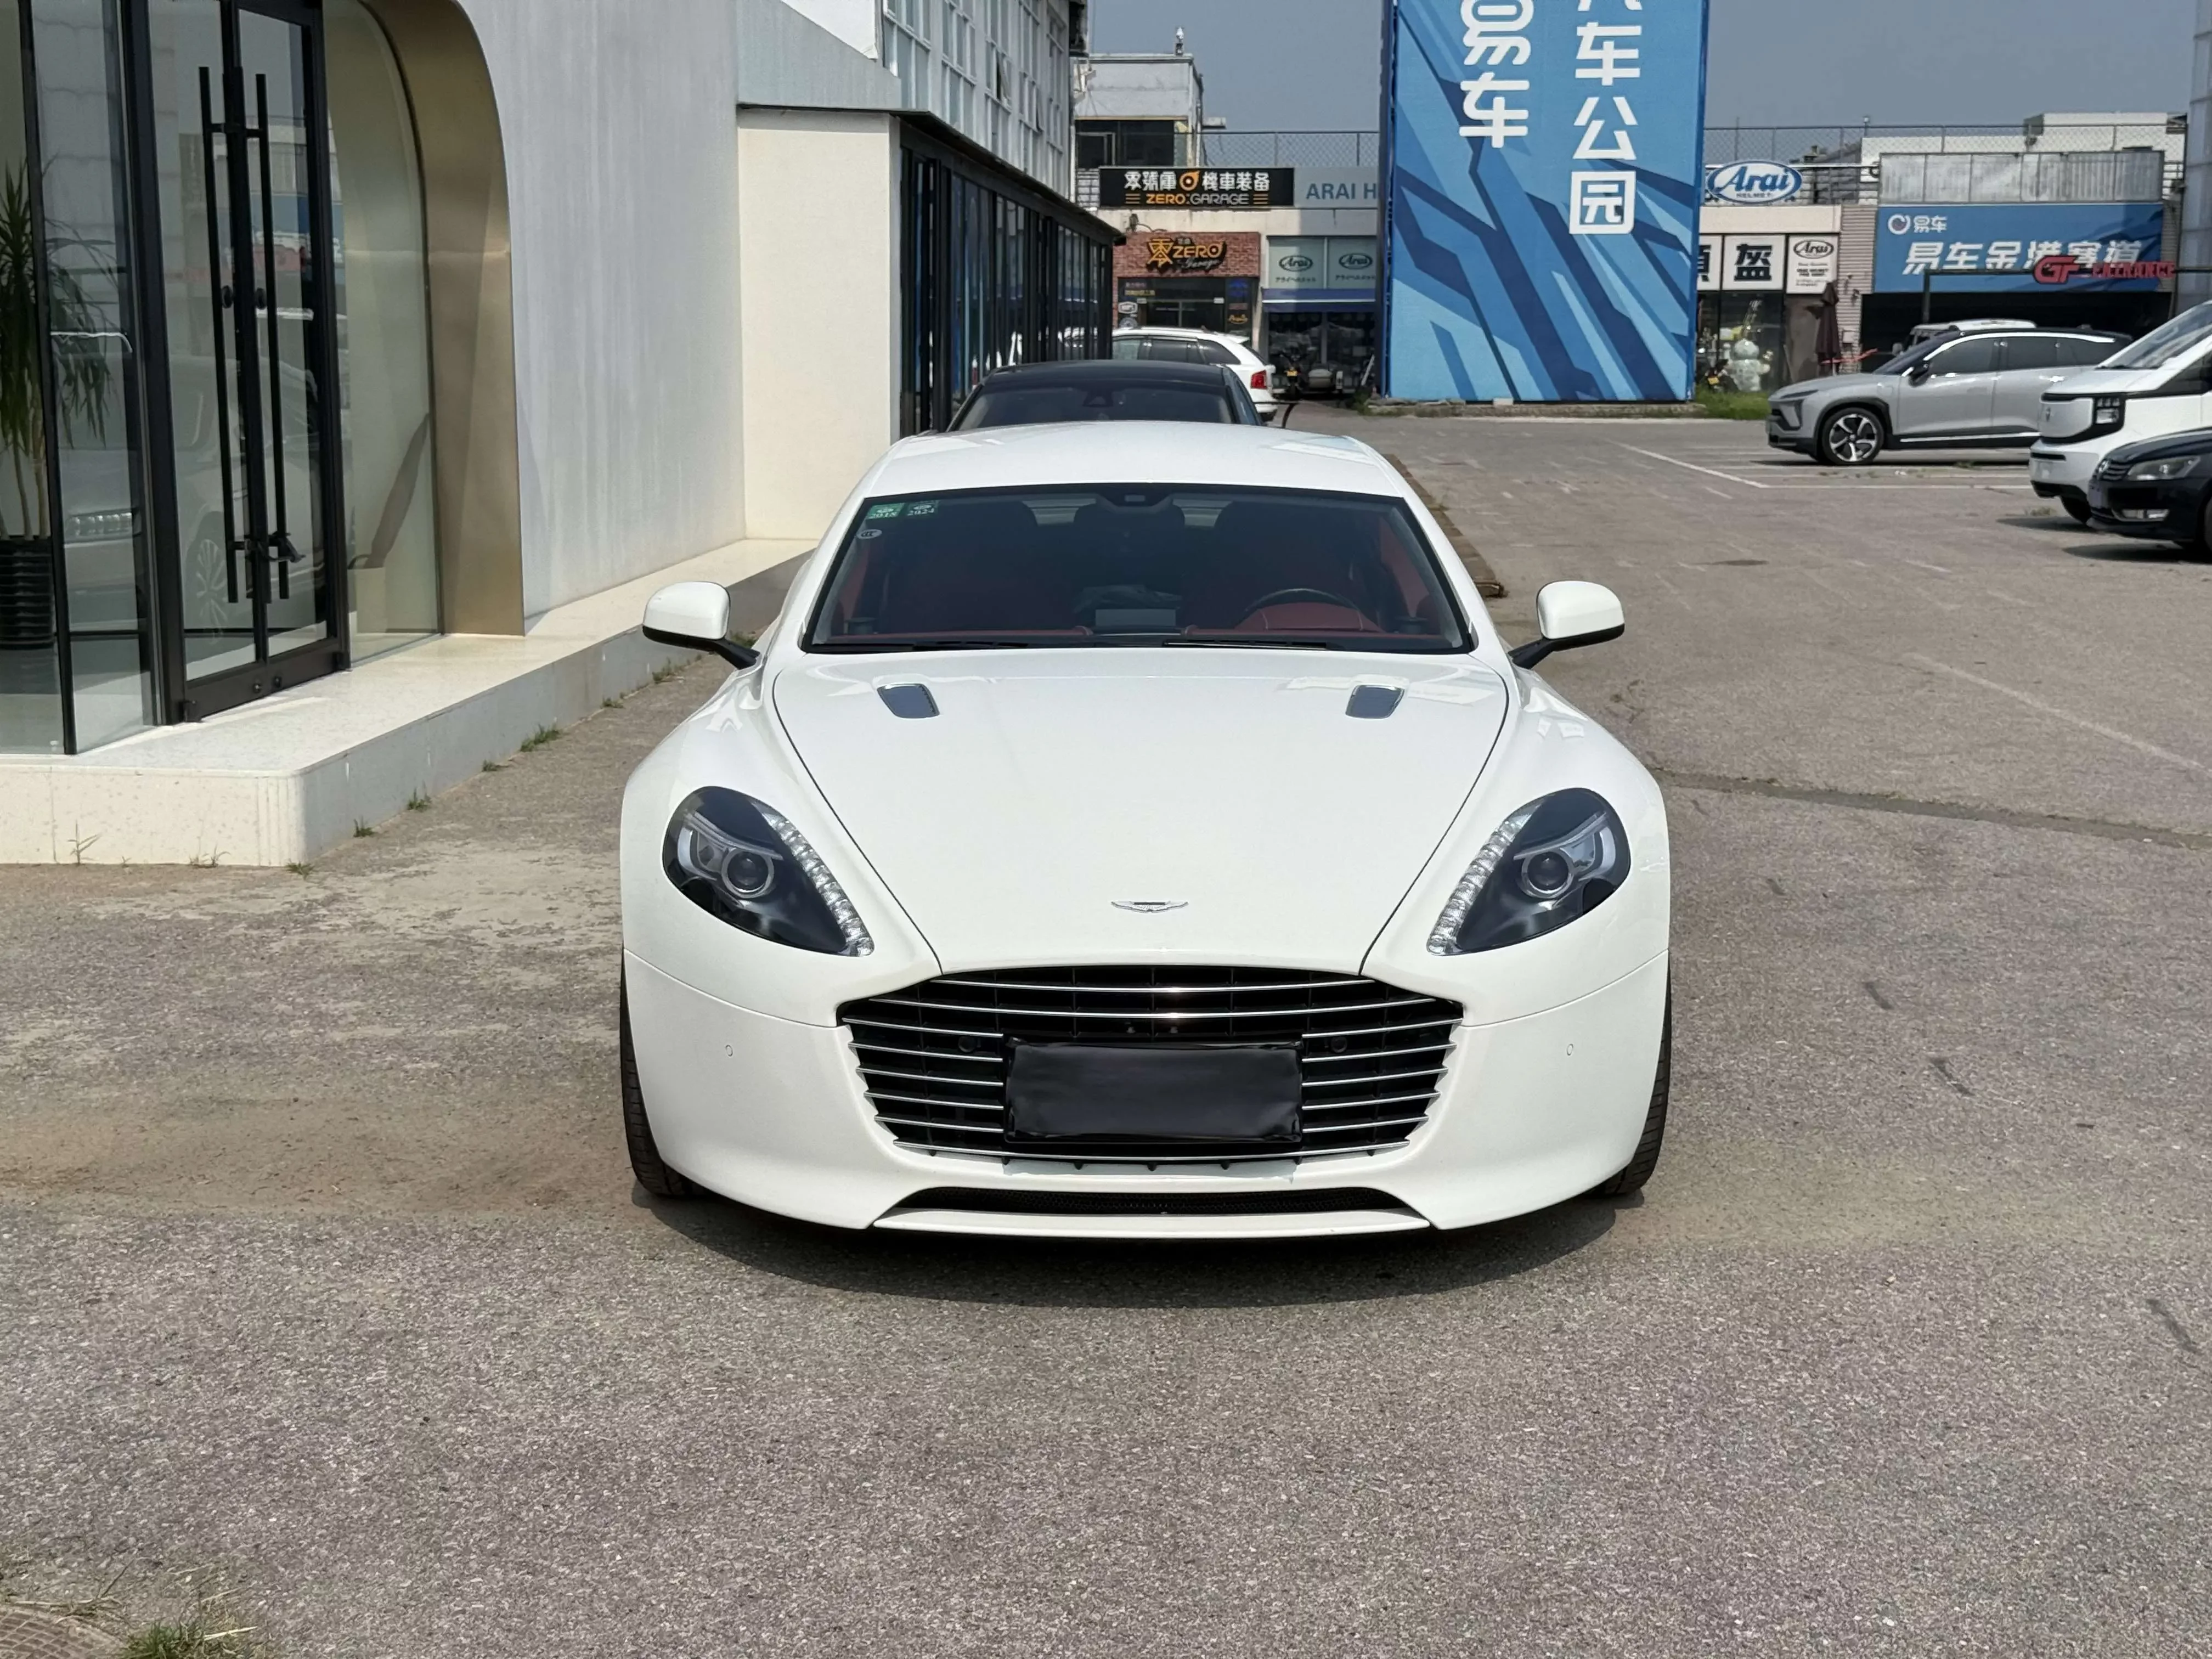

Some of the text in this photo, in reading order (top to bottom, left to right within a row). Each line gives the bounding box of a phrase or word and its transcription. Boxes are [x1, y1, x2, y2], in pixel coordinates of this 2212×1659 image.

[1569, 0, 1643, 234] 车公园
[1712, 166, 1791, 192] Arai
[1146, 194, 1250, 205] ZERO GARAGE
[1306, 183, 1356, 200] ARAI
[1914, 215, 1947, 233] 易车
[1172, 242, 1223, 258] ZERO
[1796, 241, 1829, 254] Arai
